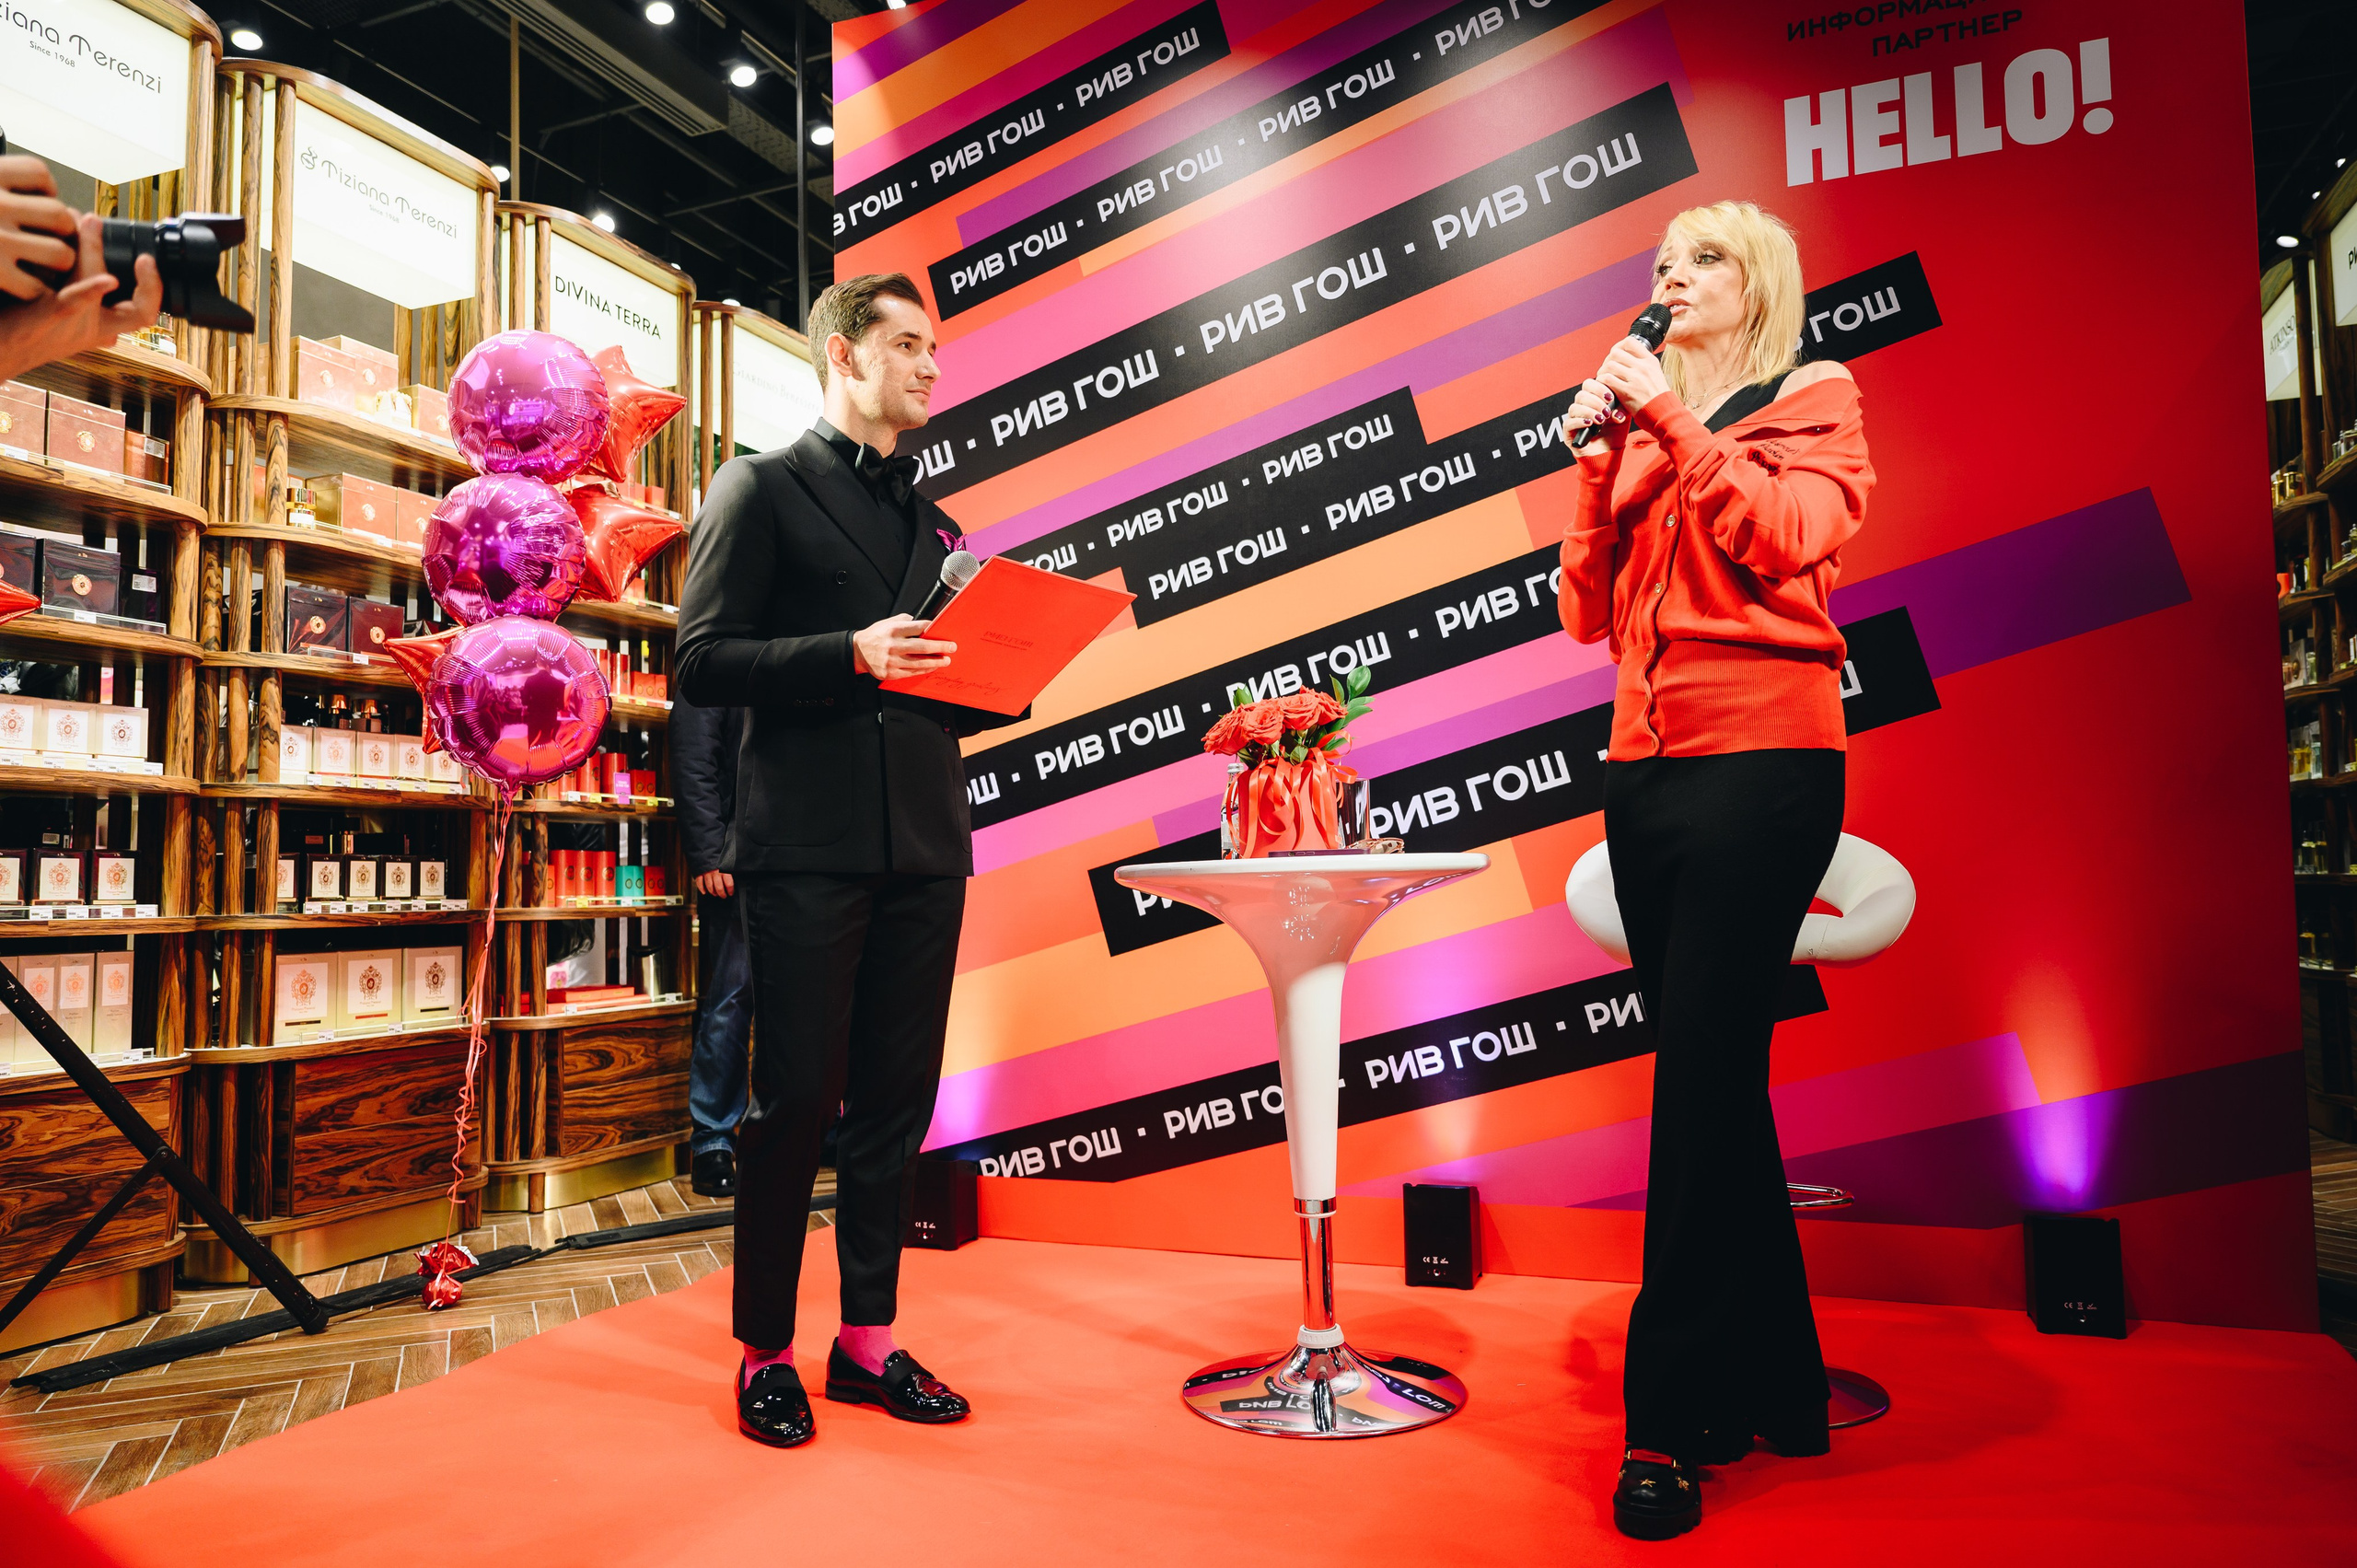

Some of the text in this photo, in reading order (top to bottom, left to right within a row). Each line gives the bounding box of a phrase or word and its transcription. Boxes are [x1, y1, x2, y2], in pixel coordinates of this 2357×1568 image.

[29, 41, 75, 68] Since 1968
[69, 34, 161, 94] Terenzi
[1873, 8, 2023, 57] ПАРТНЕР
[848, 183, 902, 226] ГОШ
[930, 142, 983, 183] РИВ
[987, 109, 1045, 154] ГОШ
[1075, 64, 1132, 107] РИВ
[1137, 28, 1200, 75] ГОШ
[950, 253, 1004, 294] РИВ
[1008, 222, 1067, 266] ГОШ
[1097, 180, 1156, 223] РИВ
[1159, 145, 1224, 192] ГОШ
[1258, 96, 1321, 143] РИВ
[1326, 59, 1396, 109] ГОШ
[1434, 6, 1504, 56] РИВ
[1784, 38, 2113, 187] HELLO!
[321, 159, 458, 239] Tiziana Terenzi
[555, 275, 662, 341] DIVINA TERRA
[991, 132, 1643, 447] РИВ ГОШ РИВ ГОШ РИВ ГОШ
[1023, 414, 1394, 573] ОШ РИВ ГОШ РИВ ГОШ
[1149, 557, 1213, 599] РИВ
[1217, 528, 1287, 574] ГОШ
[1325, 485, 1395, 530] РИВ
[1399, 453, 1476, 502] ГОШ
[1515, 412, 1568, 457] РИ
[1809, 287, 1900, 343] ГОШ
[1035, 735, 1104, 780] РИВ
[1109, 705, 1185, 754] ГОШ
[1306, 632, 1391, 684] ГОШ
[1435, 587, 1519, 638] РИВ
[1369, 750, 1571, 839] РИВ ГОШ
[1050, 1128, 1121, 1167] ГОШ
[1164, 1098, 1236, 1139] РИВ
[1240, 1086, 1285, 1121] ГО
[1364, 1046, 1445, 1088] РИВ
[1449, 1022, 1537, 1069] ГОШ
[1585, 993, 1646, 1033] РИ
